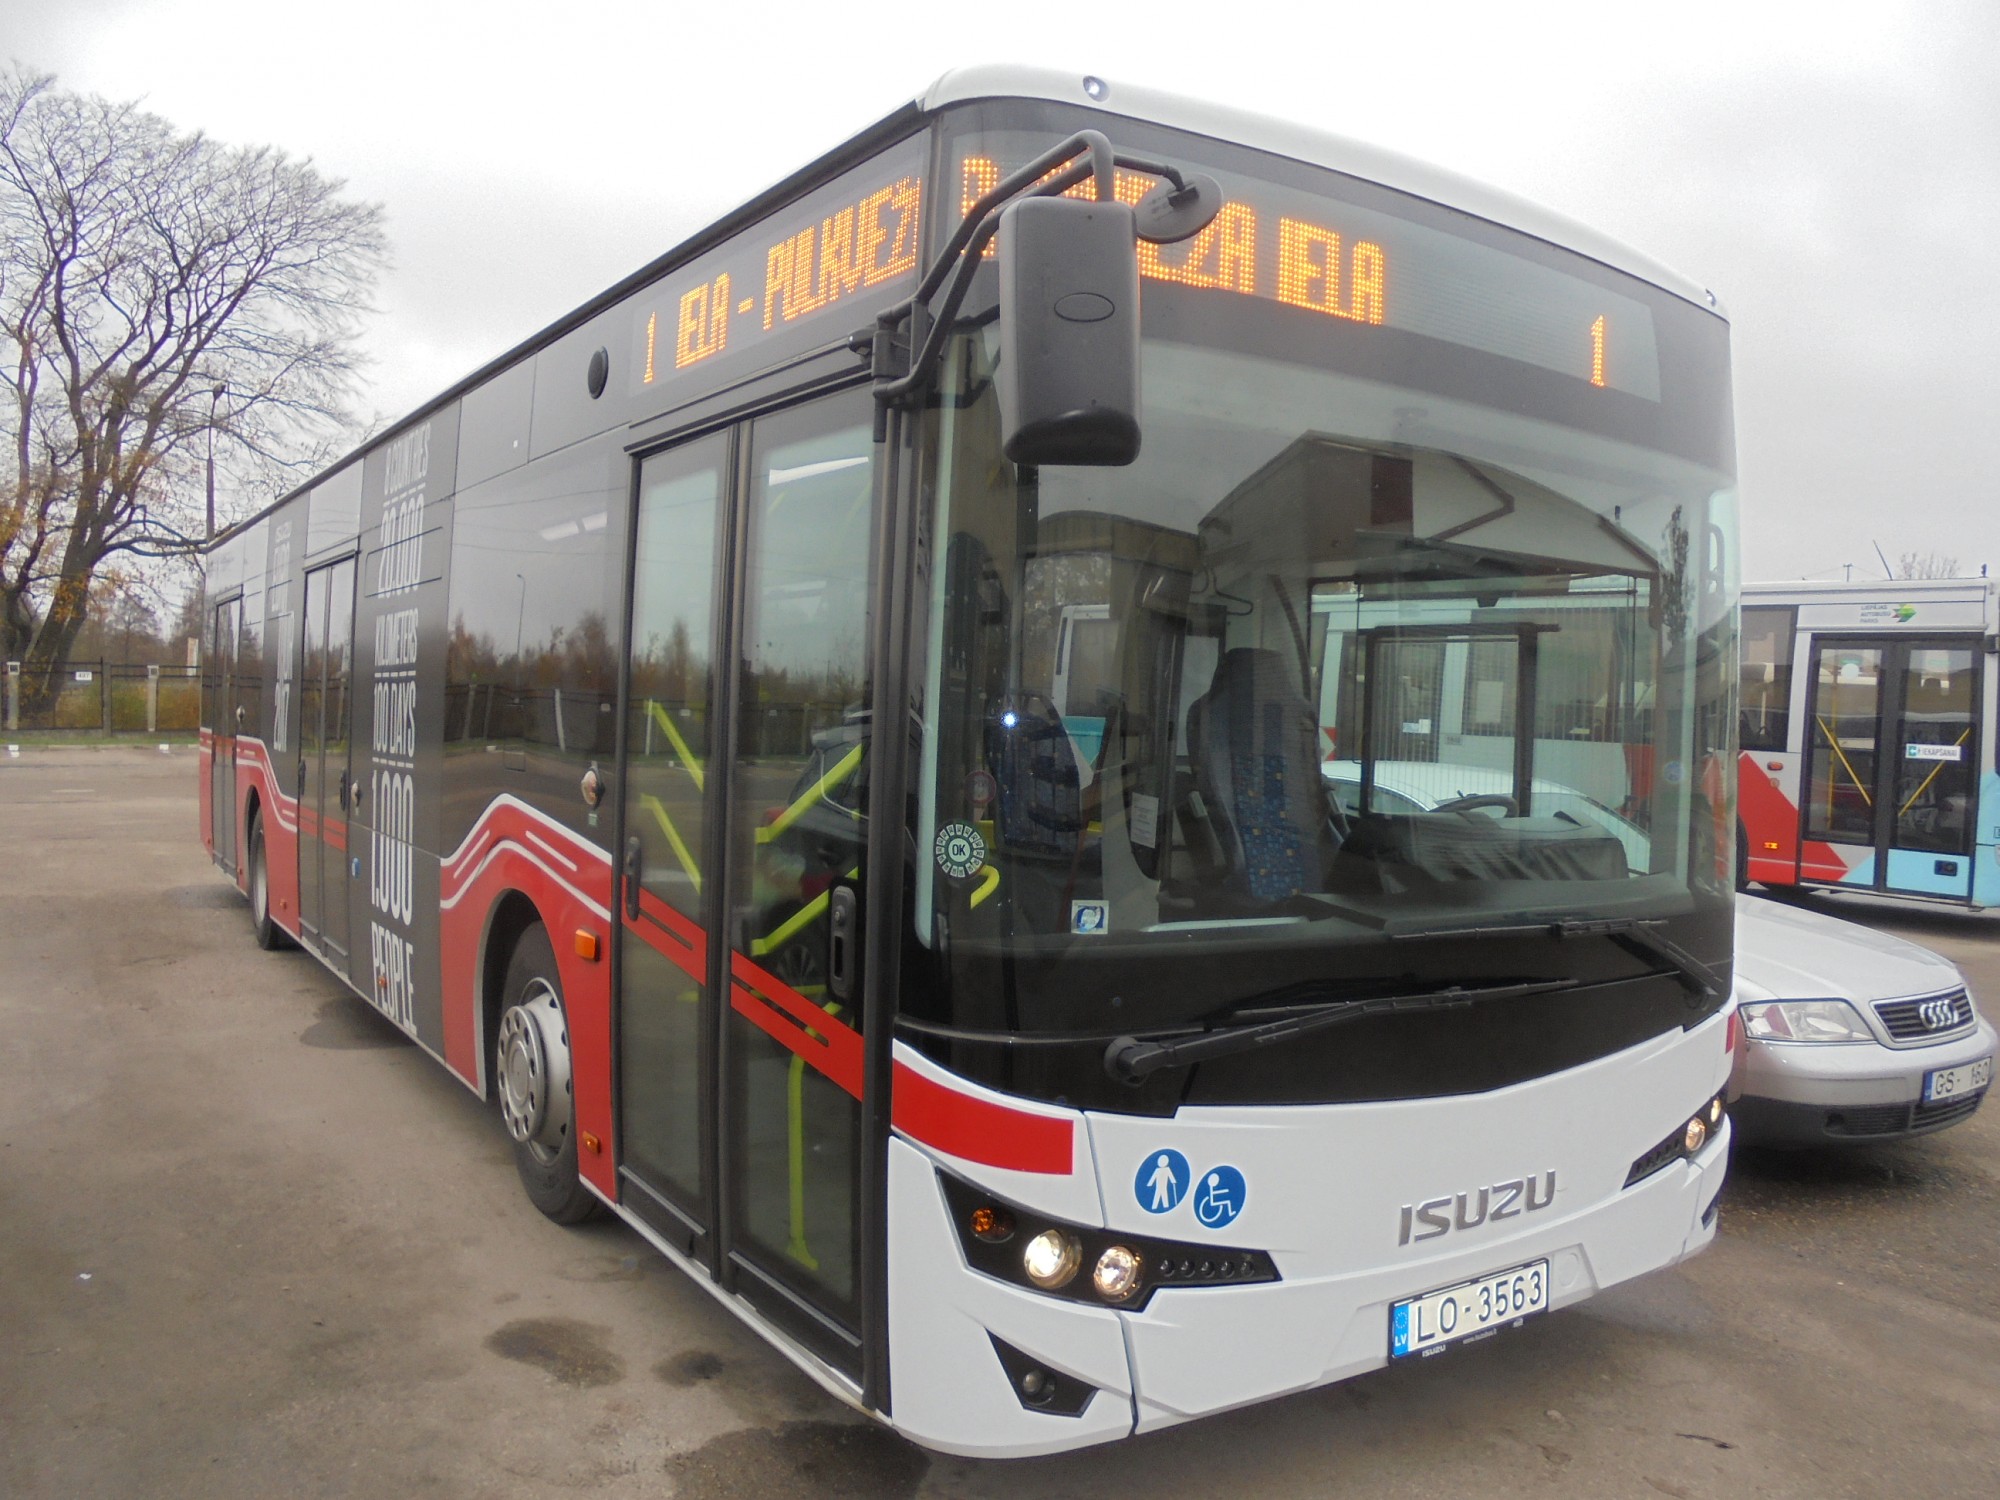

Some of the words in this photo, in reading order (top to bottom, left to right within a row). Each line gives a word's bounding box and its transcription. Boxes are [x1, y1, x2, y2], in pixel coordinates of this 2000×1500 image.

[1590, 313, 1606, 387] 1
[377, 492, 425, 600] 20.000
[373, 682, 390, 752] 100
[389, 680, 417, 758] DAYS
[371, 769, 414, 926] 1.000
[952, 844, 966, 857] OK
[370, 920, 418, 1036] PEOPLE
[1398, 1168, 1557, 1248] ISUZU
[1394, 1333, 1408, 1348] LV
[1416, 1269, 1543, 1343] LO-3563
